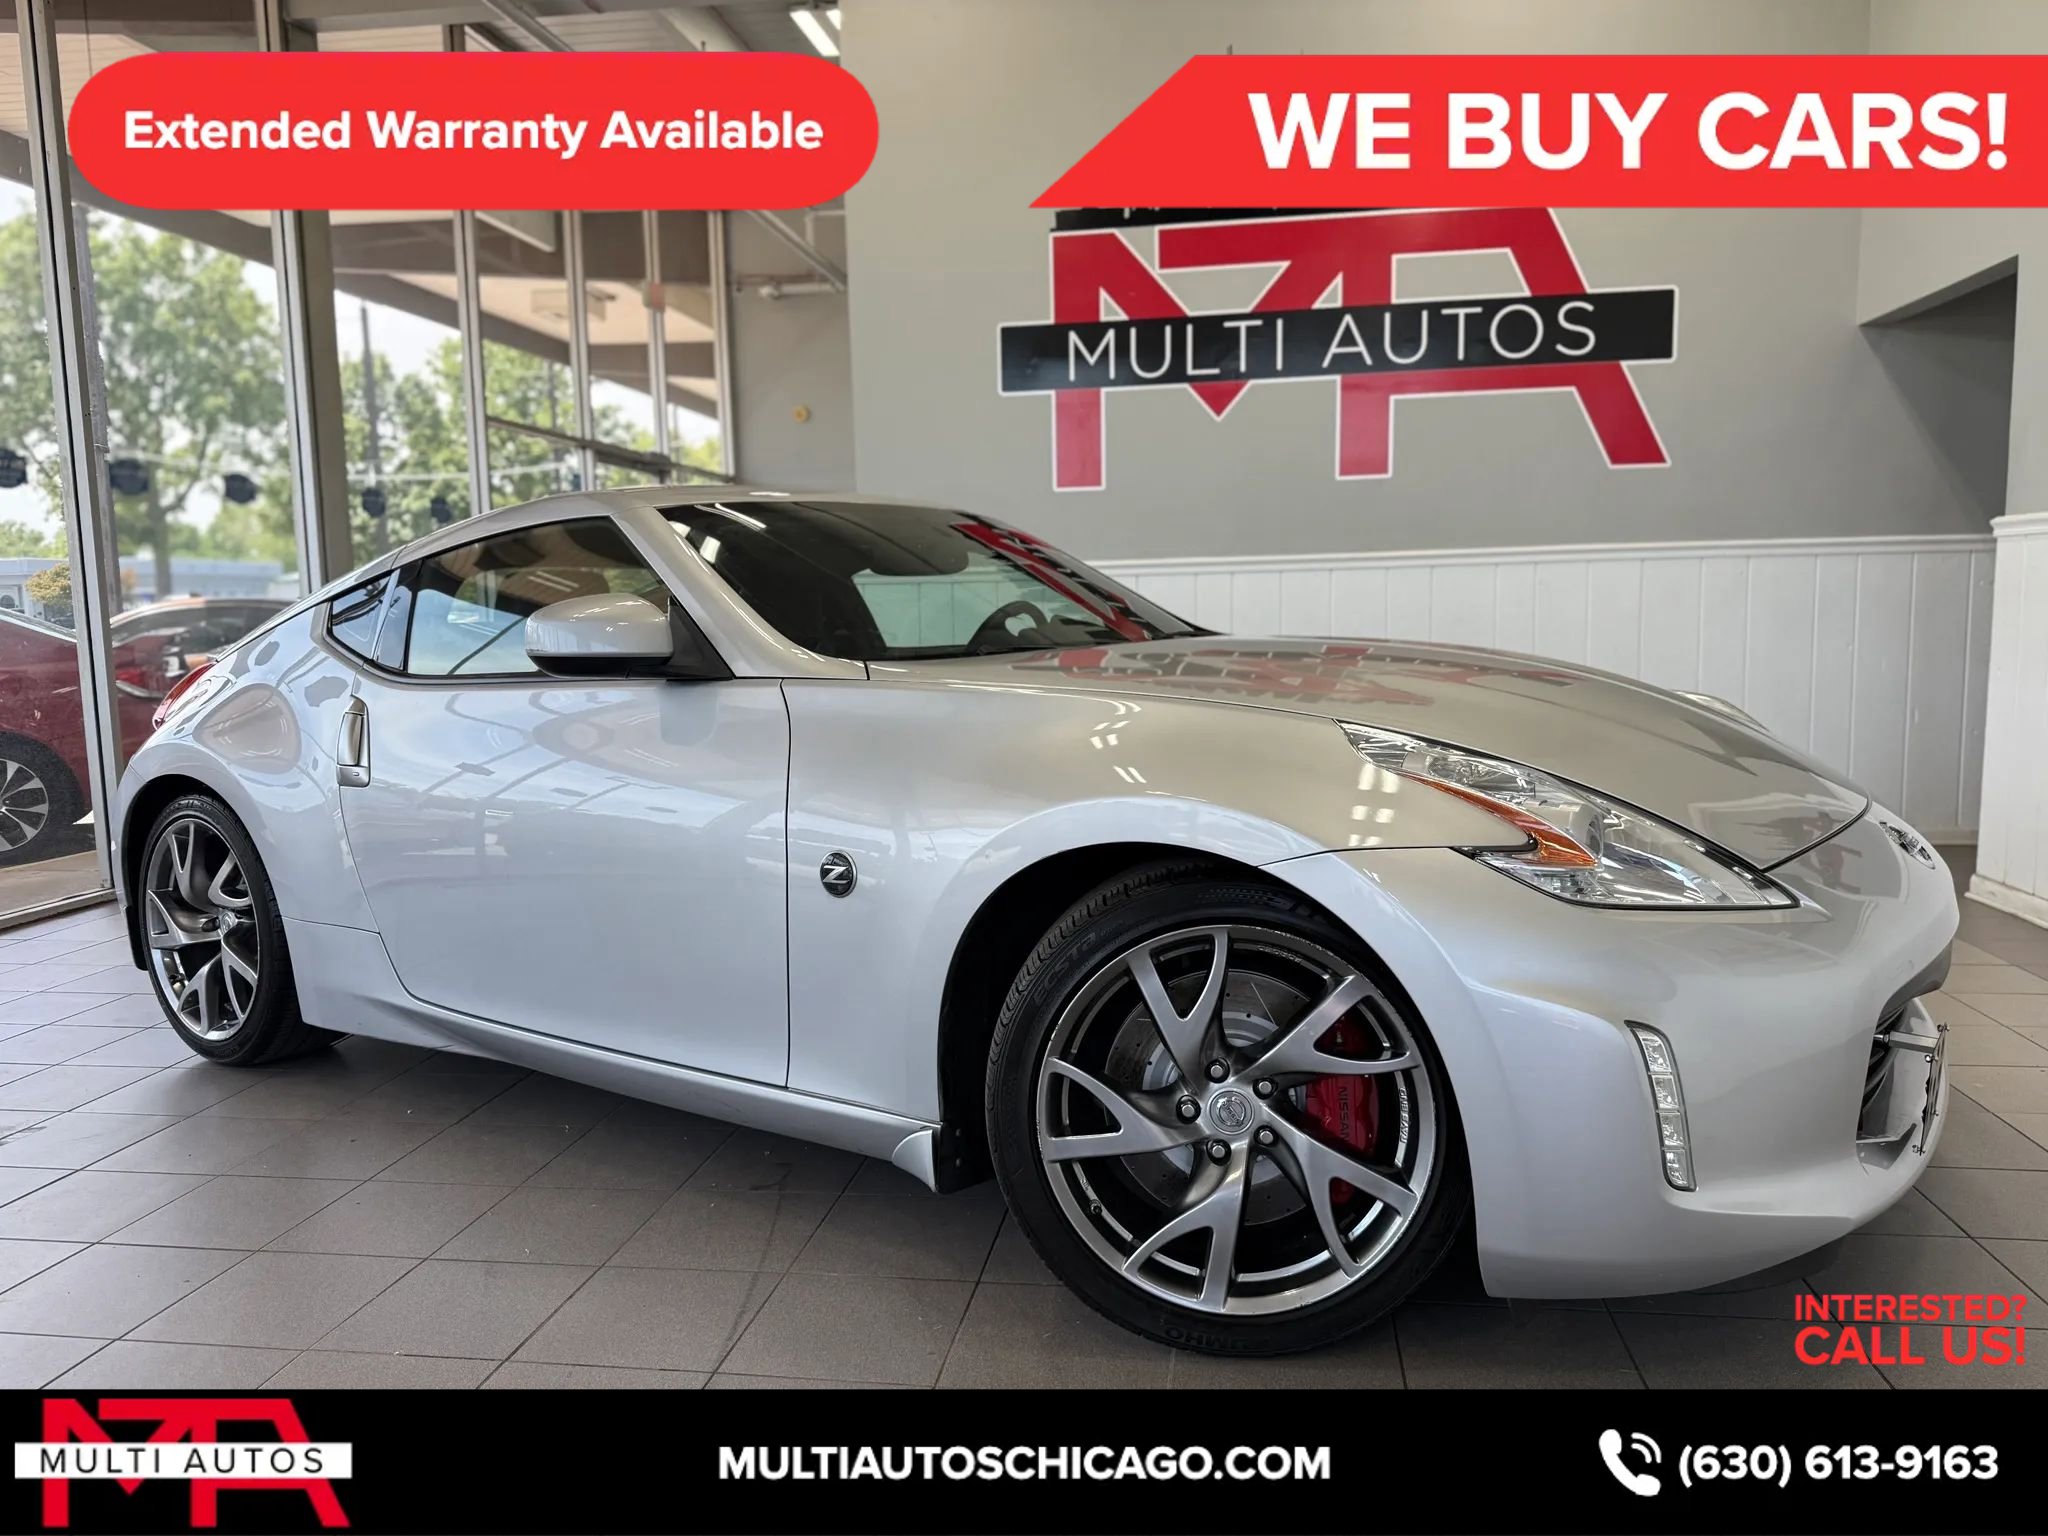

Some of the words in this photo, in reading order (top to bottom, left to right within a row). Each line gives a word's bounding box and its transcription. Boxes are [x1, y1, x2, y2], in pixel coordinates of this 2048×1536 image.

[1068, 317, 1283, 382] MULTI
[1322, 301, 1597, 368] AUTOS
[1338, 1086, 1350, 1140] NISSAN
